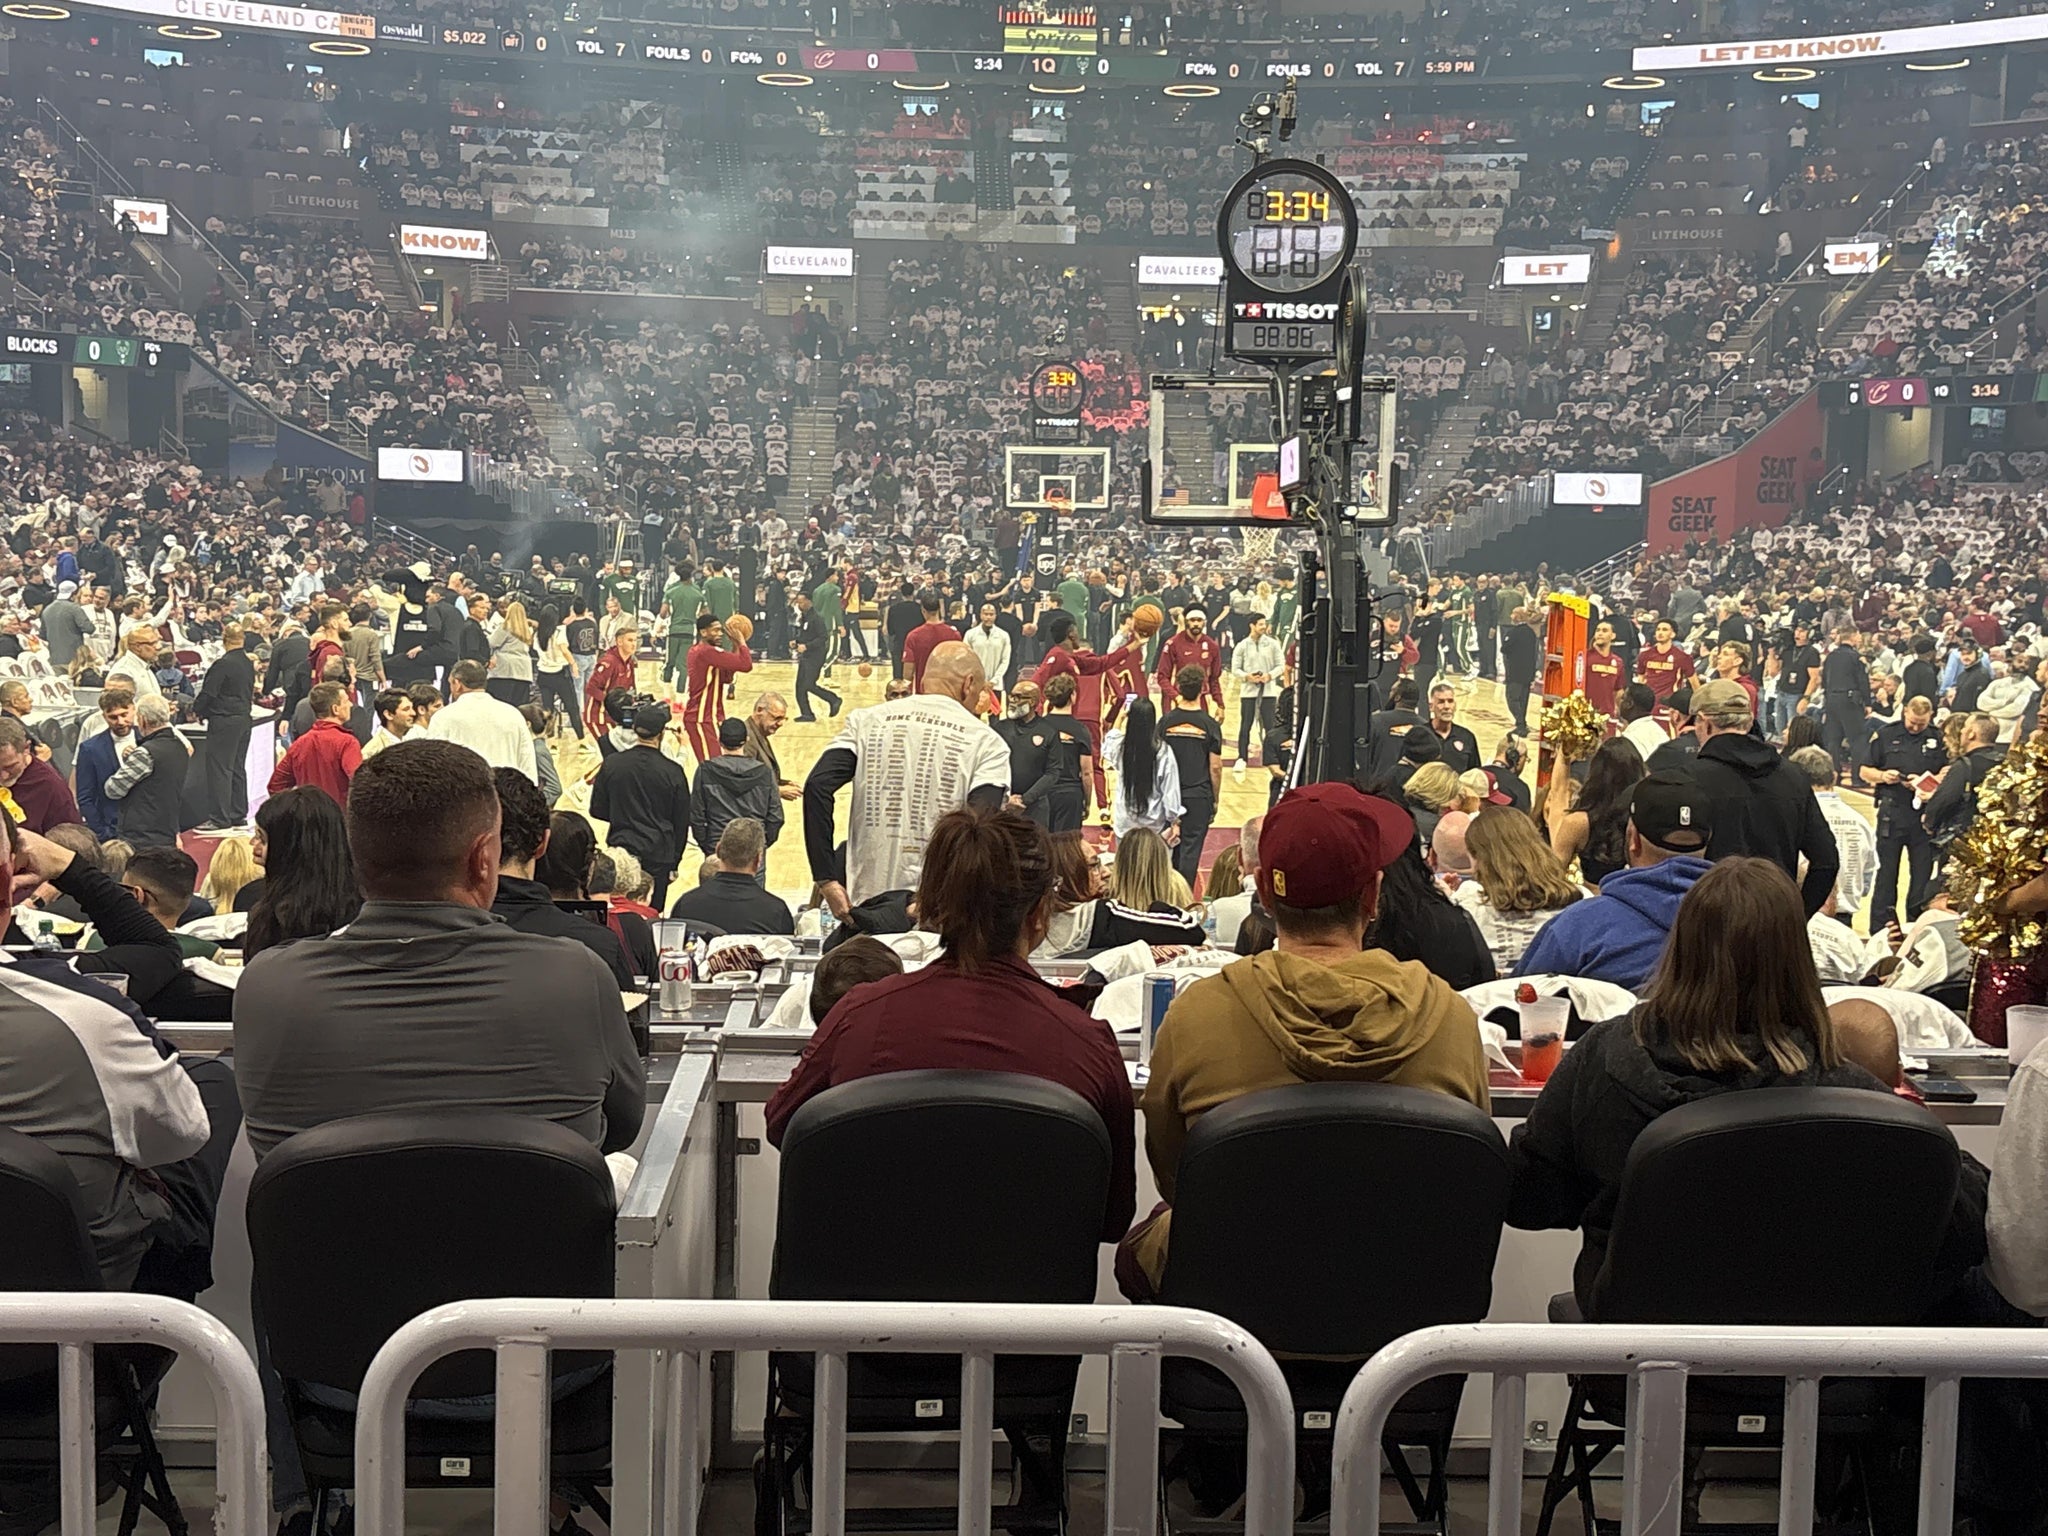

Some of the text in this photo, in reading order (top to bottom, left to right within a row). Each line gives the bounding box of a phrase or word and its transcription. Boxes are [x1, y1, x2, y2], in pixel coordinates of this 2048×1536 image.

[176, 0, 304, 27] CLEVELAND
[341, 16, 374, 26] TONIGHT'S
[348, 27, 366, 36] TOTAL
[382, 24, 423, 38] oswald
[443, 30, 486, 45] $5,022
[536, 37, 546, 50] 0
[576, 40, 626, 56] TOL 7
[1700, 36, 1886, 63] LET EM KNOW.
[646, 46, 712, 63] FOULS 0
[730, 52, 787, 66] FG% 0
[867, 54, 878, 68] 0
[974, 58, 1002, 70] 3:34
[1032, 58, 1056, 74] 1Q
[1098, 60, 1110, 74] 0
[1184, 64, 1239, 78] FG% 0
[1266, 64, 1334, 78] FOULS 0
[1354, 62, 1404, 76] TOL 7
[1425, 62, 1475, 73] 5:59 PM
[288, 194, 360, 210] LITEHOUSE
[1265, 190, 1330, 222] 3:34
[1652, 228, 1724, 240] LITEHOUSE
[403, 232, 484, 252] KNOW.
[772, 255, 847, 266] CLEVELAND
[1834, 252, 1868, 266] EM
[1145, 264, 1216, 276] CAVALIERS
[1524, 262, 1568, 276] LET
[1262, 303, 1339, 320] TISSOT
[7, 336, 58, 354] BLOCKS
[88, 341, 100, 360] 0
[148, 353, 158, 366] 0
[1048, 372, 1076, 386] 3:34
[1902, 384, 1914, 400] 0
[1971, 384, 2000, 397] 3:34
[1048, 418, 1080, 427] TISSOT
[1760, 456, 1798, 480] SEAT
[1756, 481, 1798, 504] GEEK
[1672, 496, 1717, 514] SEAT
[1668, 515, 1717, 532] GEEK
[1039, 560, 1055, 572] ups
[578, 627, 594, 652] 25
[885, 714, 967, 734] HOME SCHEDULE
